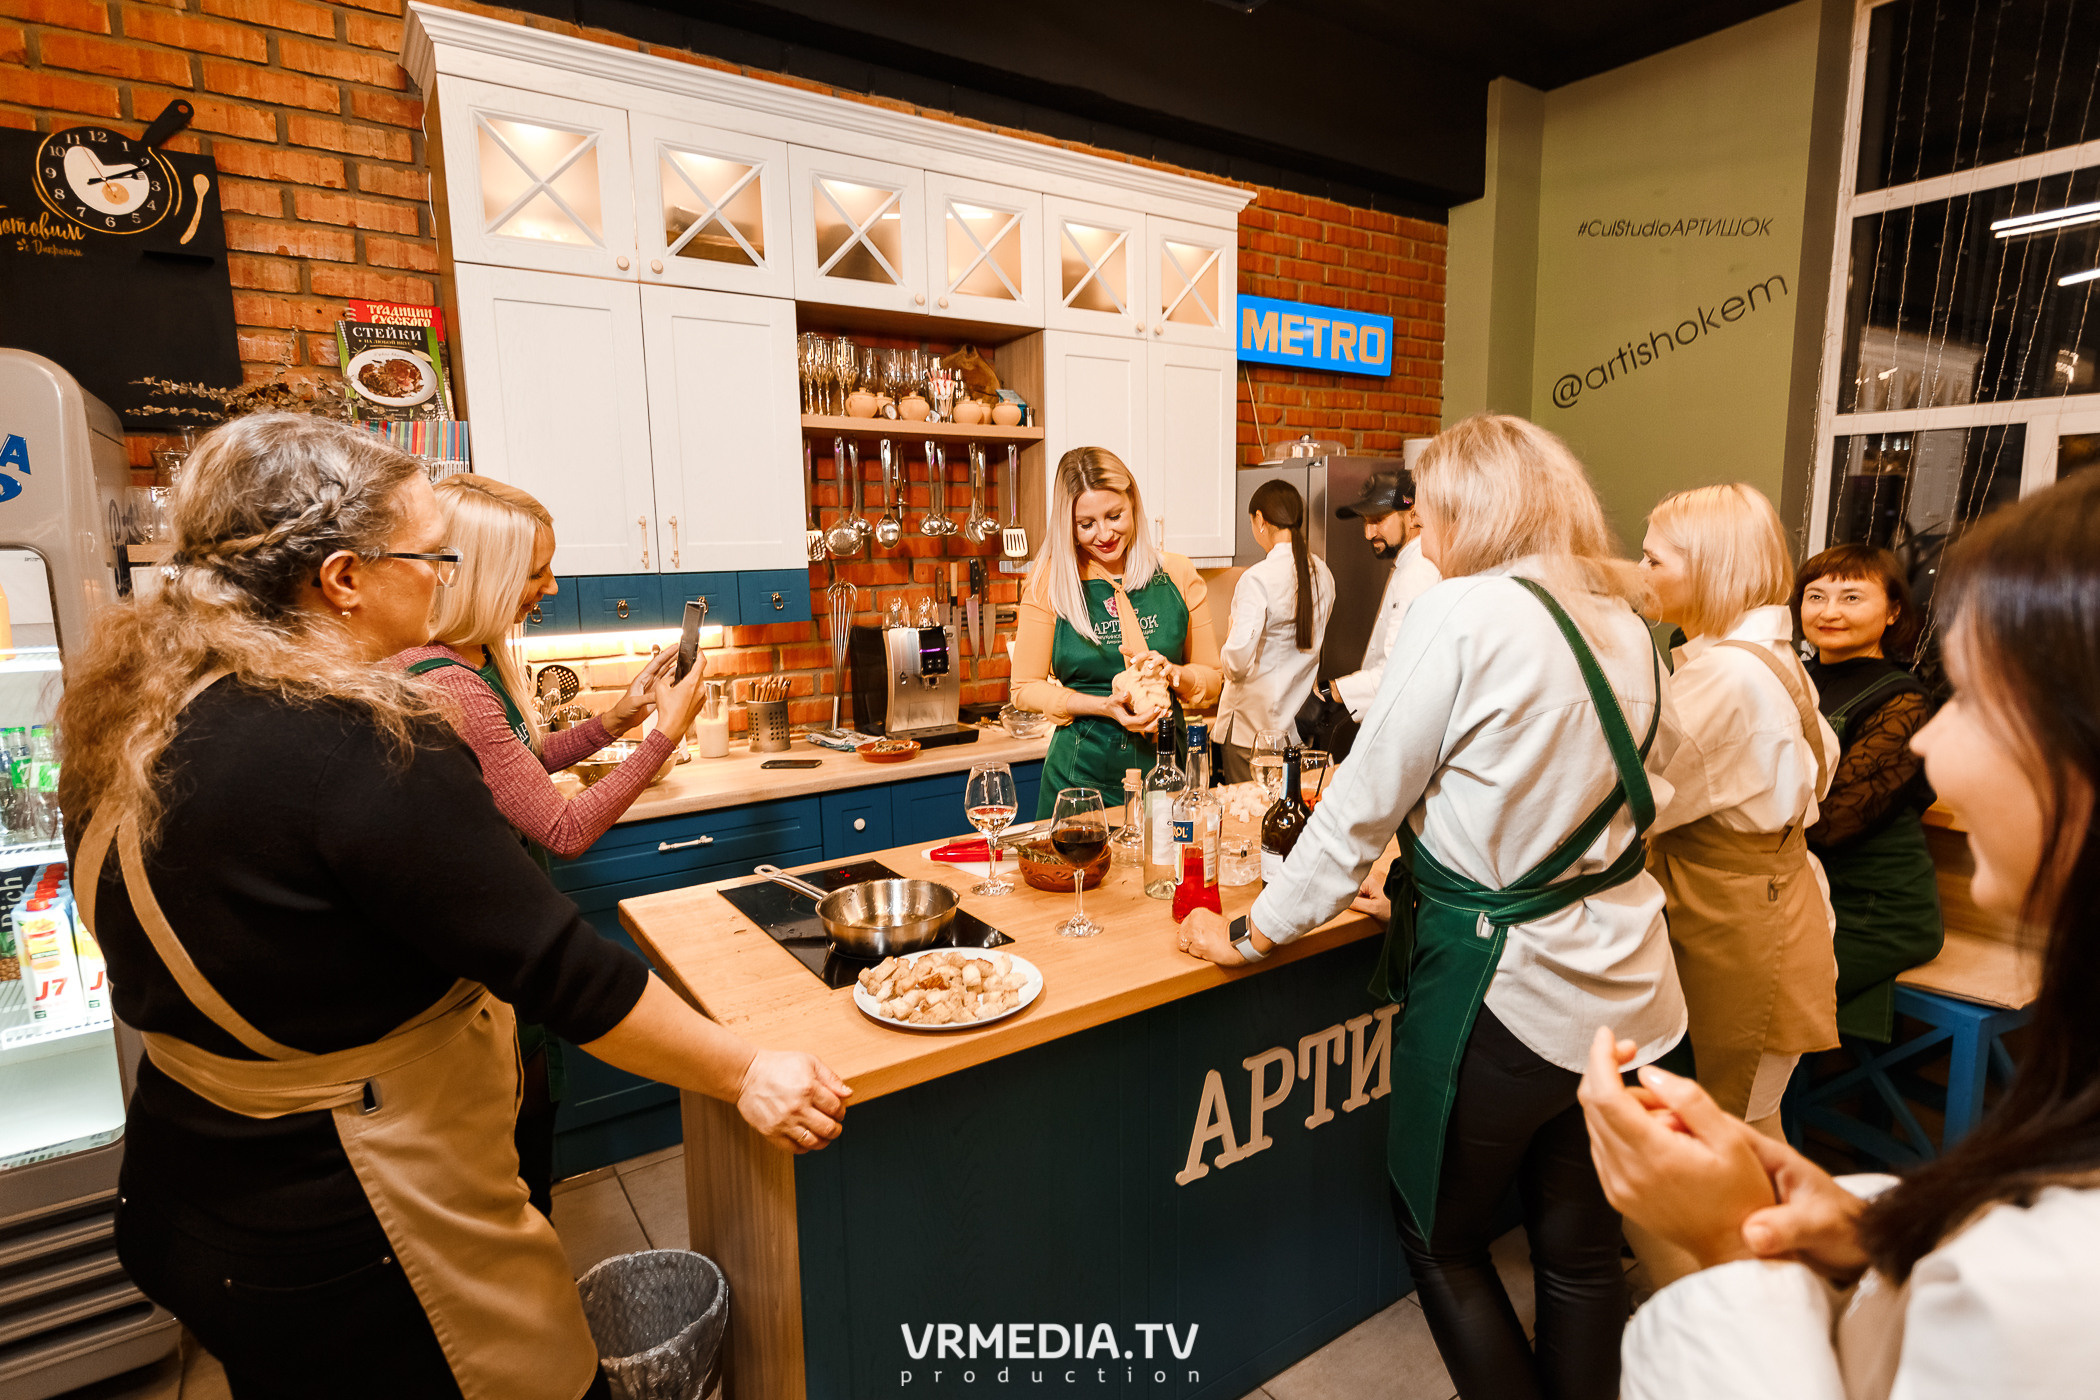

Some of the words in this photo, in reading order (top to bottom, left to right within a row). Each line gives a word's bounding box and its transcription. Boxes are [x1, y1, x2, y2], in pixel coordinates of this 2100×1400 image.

[66, 133, 81, 145] 11
[88, 130, 108, 143] 12
[50, 146, 66, 158] 10
[121, 141, 131, 152] 1
[45, 167, 57, 179] 9
[151, 180, 161, 192] 3
[54, 188, 66, 200] 8
[146, 200, 157, 211] 4
[76, 206, 86, 218] 7
[131, 212, 142, 224] 5
[0, 211, 86, 241] отовим
[105, 216, 117, 228] 6
[1577, 217, 1774, 238] #CulStudioАРТИШОК
[366, 304, 433, 319] ТРАДИЦИИ
[371, 314, 431, 328] РУССКОГО
[352, 326, 422, 341] СТЕЙКИ
[1241, 308, 1386, 365] METRO
[1552, 274, 1788, 409] @artishokem
[35, 977, 68, 1002] J7
